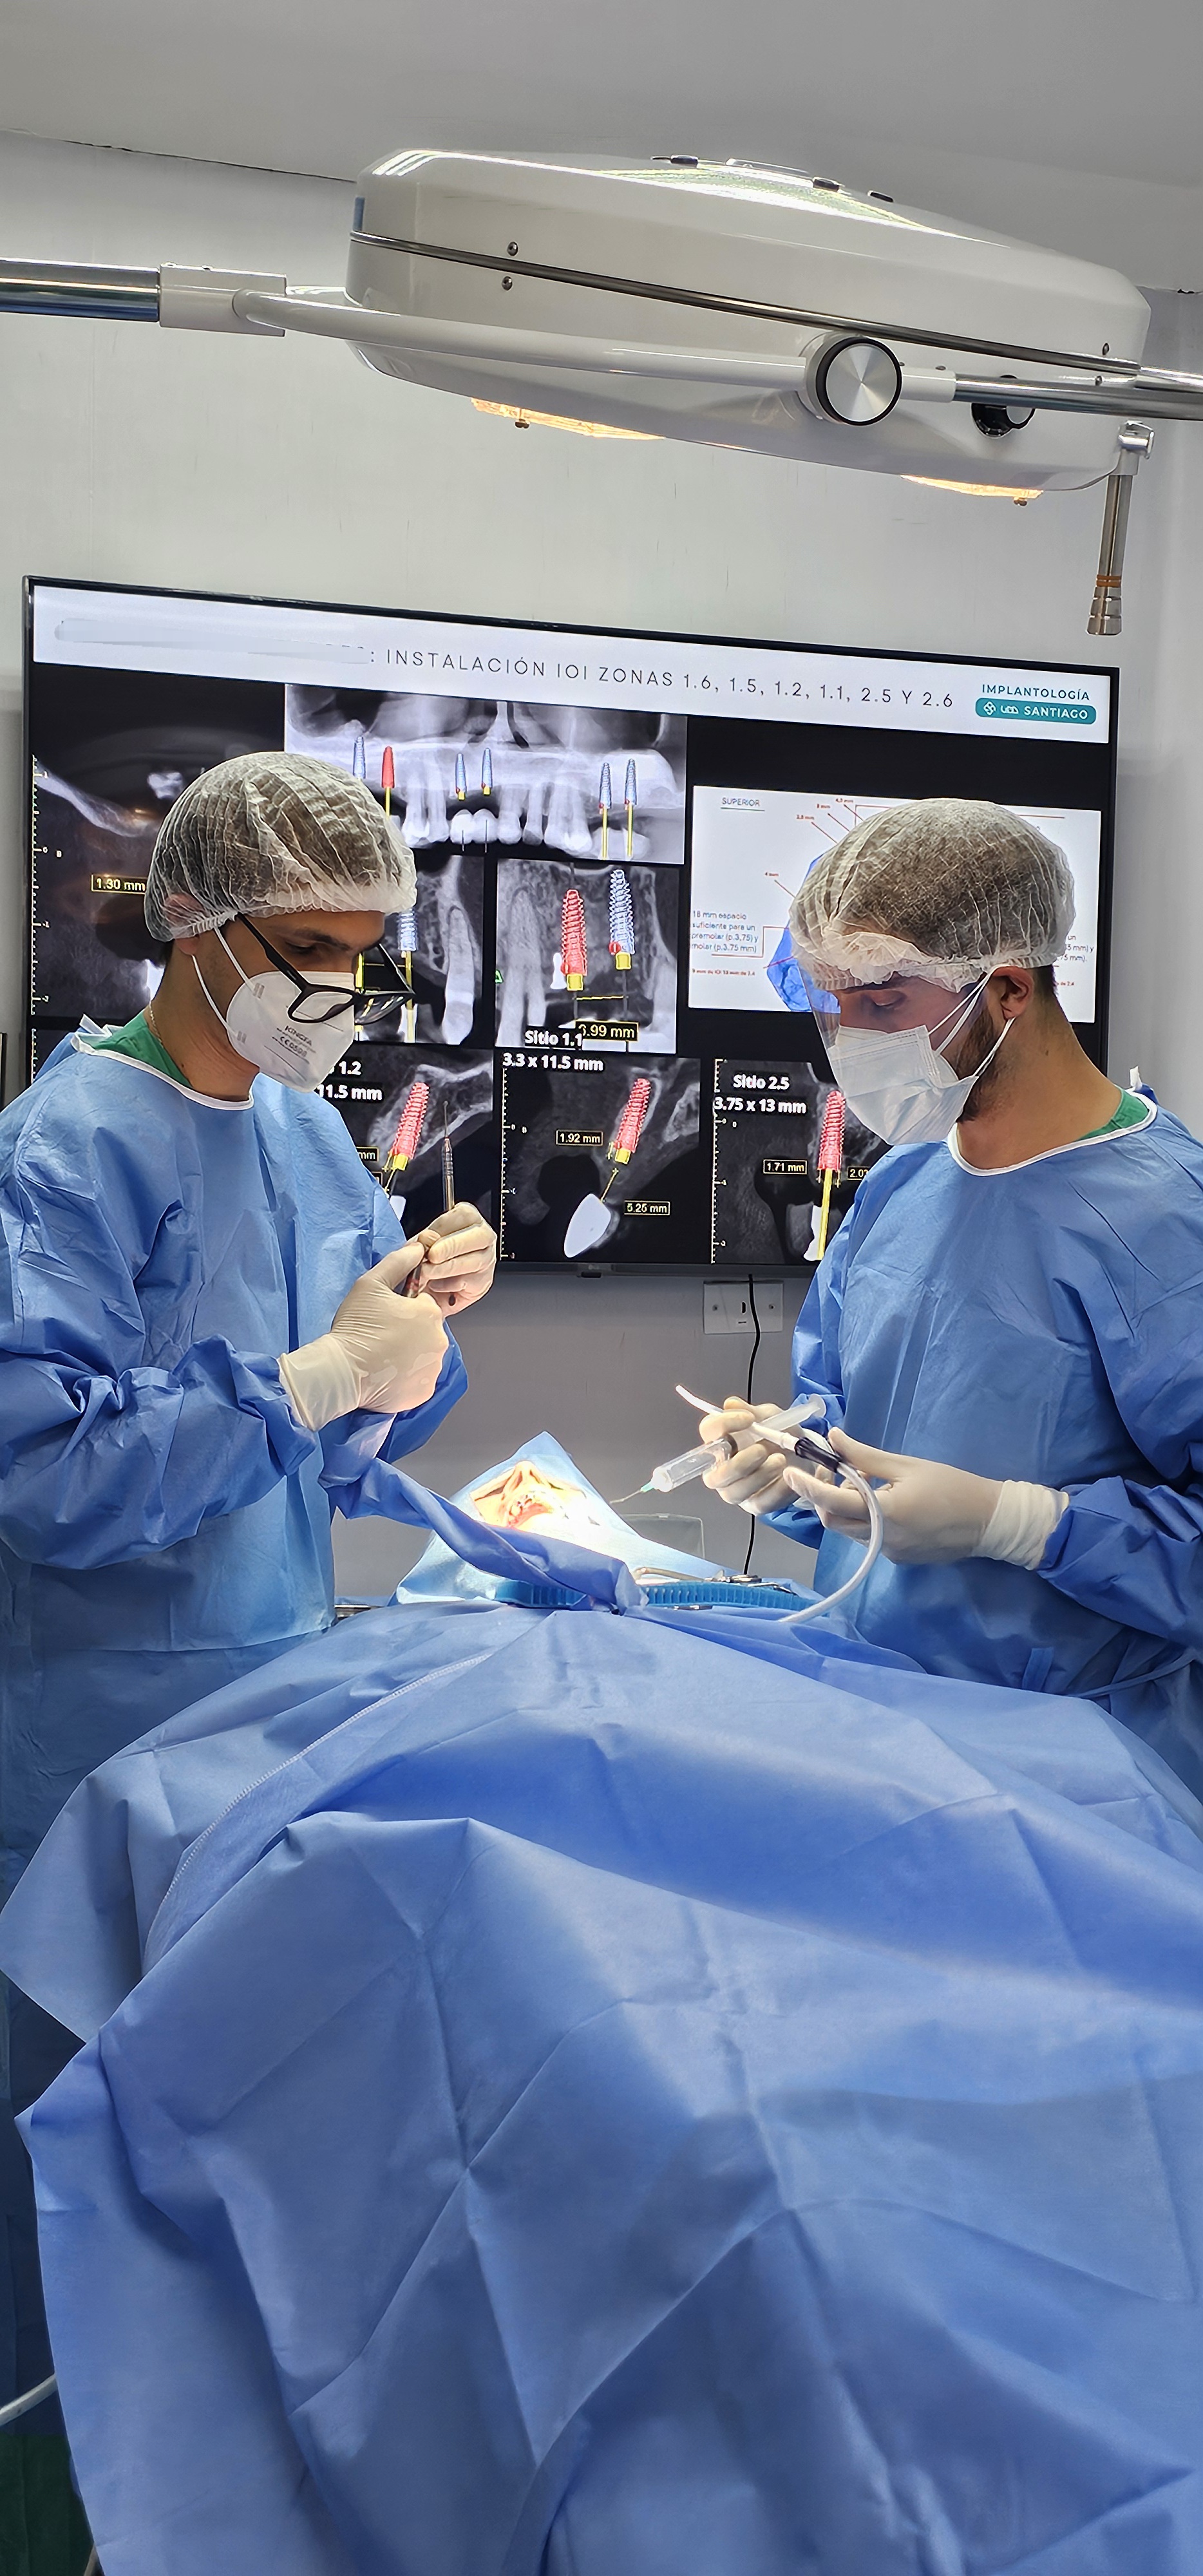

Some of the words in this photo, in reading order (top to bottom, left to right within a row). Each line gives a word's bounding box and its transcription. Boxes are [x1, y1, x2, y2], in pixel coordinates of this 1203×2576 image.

[387, 649, 545, 676] INSTALACIÓN
[558, 666, 587, 680] IOI
[599, 667, 672, 687] ZONAS
[684, 674, 719, 692] 1.6,
[730, 677, 764, 696] 1.5,
[775, 681, 810, 699] 1.2,
[820, 684, 850, 702] 1.1,
[861, 688, 891, 703] 2.5
[902, 690, 912, 705] Y
[923, 692, 952, 708] 2.6
[982, 684, 1090, 701] IMPLANTOLOGÍA
[1024, 706, 1088, 719] SANTIAGO
[722, 797, 760, 806] SUPERIOR
[96, 878, 120, 889] 1.30
[124, 880, 146, 891] mm
[524, 1030, 558, 1045] Sitio
[562, 1034, 582, 1046] 1.1
[611, 1028, 634, 1038] mm
[339, 1061, 361, 1075] 1.2
[502, 1053, 525, 1067] 3.3
[528, 1057, 537, 1066] x
[541, 1055, 570, 1070] 11.5
[574, 1058, 603, 1070] mm
[733, 1074, 766, 1090] Sitio
[768, 1076, 790, 1090] 2.5
[351, 1088, 383, 1100] mm
[714, 1097, 744, 1111] 3.75
[746, 1101, 755, 1111] x
[759, 1099, 775, 1112] 13
[779, 1102, 806, 1113] mm
[560, 1133, 580, 1142] 1.92
[582, 1135, 600, 1143] mm
[766, 1162, 784, 1171] 1.71
